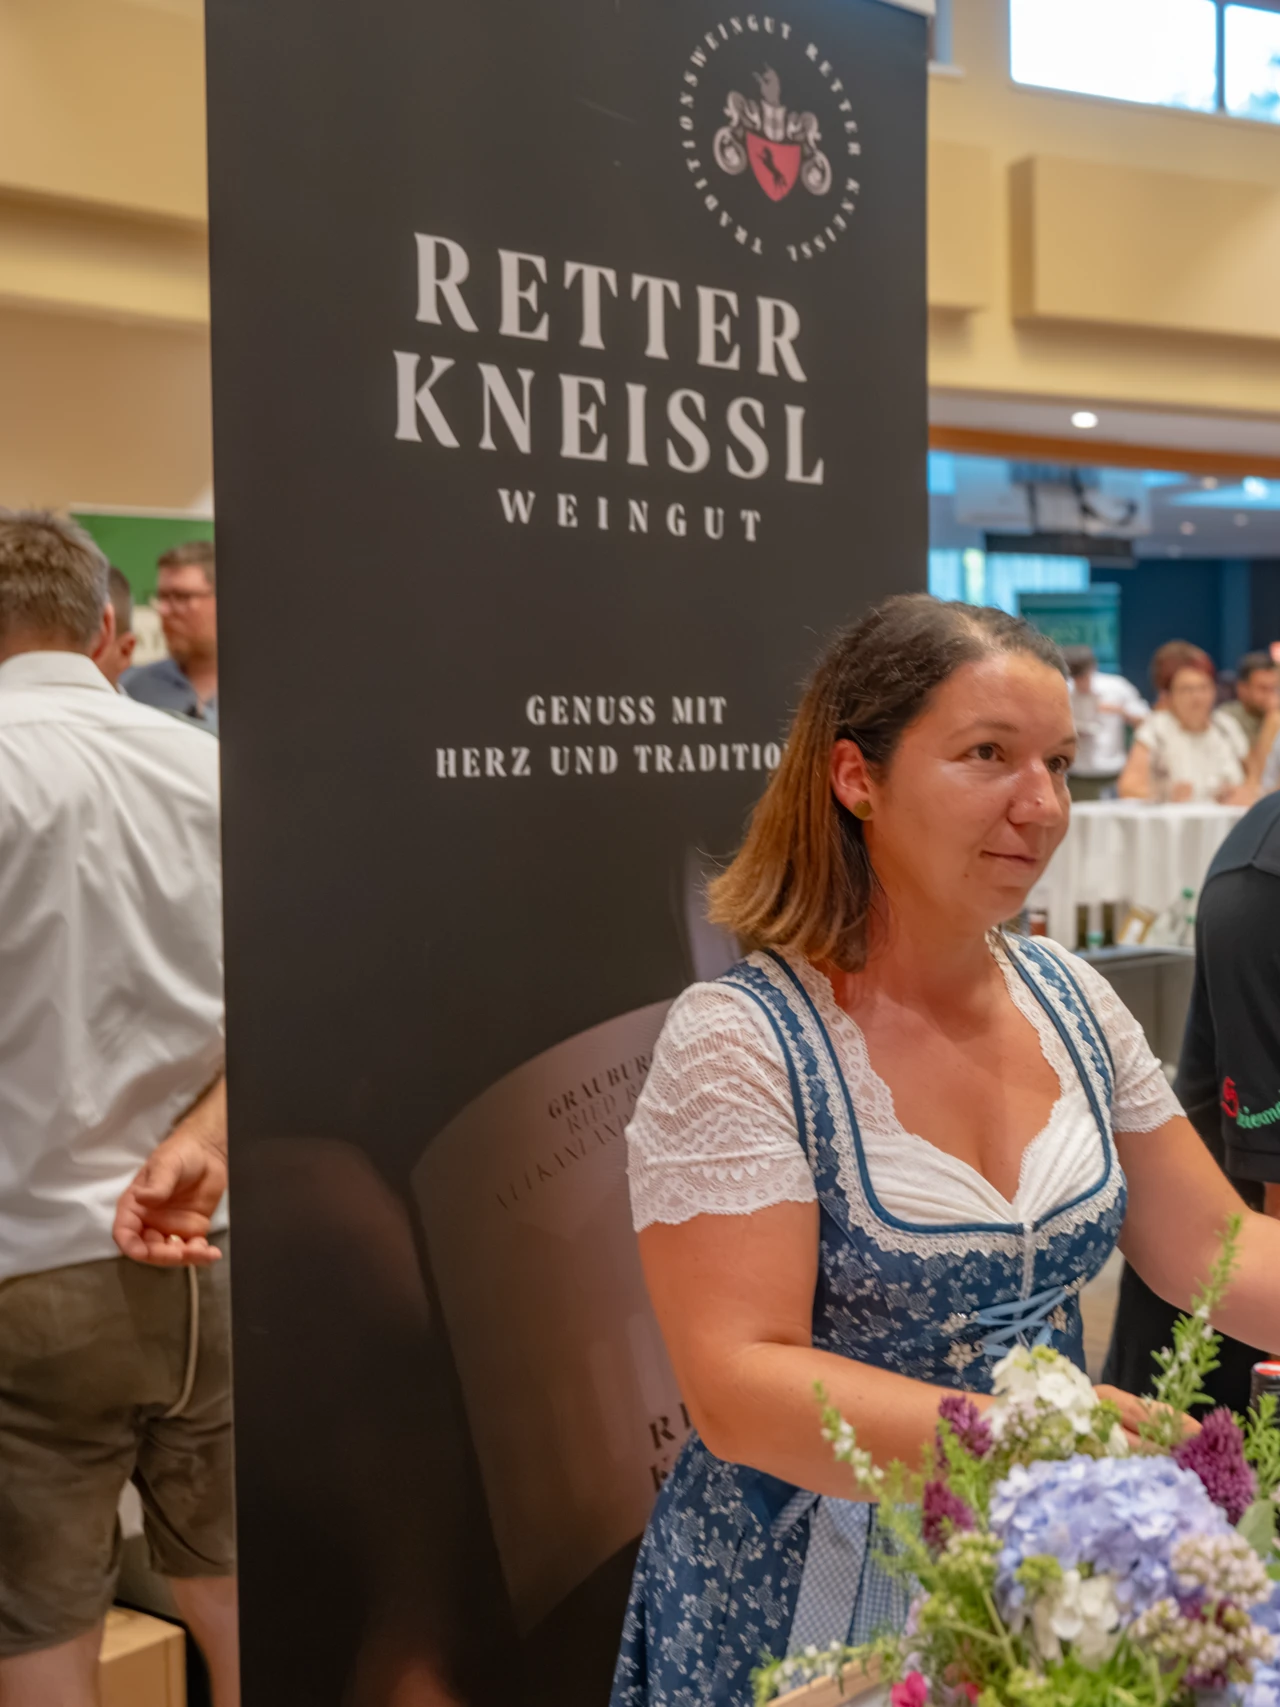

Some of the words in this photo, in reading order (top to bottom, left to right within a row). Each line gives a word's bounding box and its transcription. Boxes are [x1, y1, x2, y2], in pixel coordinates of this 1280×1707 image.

[679, 14, 792, 255] TRADITIONSWEINGUT
[805, 42, 862, 156] RETTER
[786, 177, 861, 262] KNEISSL
[414, 232, 808, 382] RETTER
[393, 350, 825, 485] KNEISSL
[497, 487, 761, 542] WEINGUT
[525, 694, 657, 726] GENUSS
[671, 696, 728, 725] MIT
[435, 746, 533, 778] HERZ
[549, 744, 619, 776] UND
[633, 741, 791, 774] TRADITIO
[547, 1053, 654, 1120] GRAUBUR
